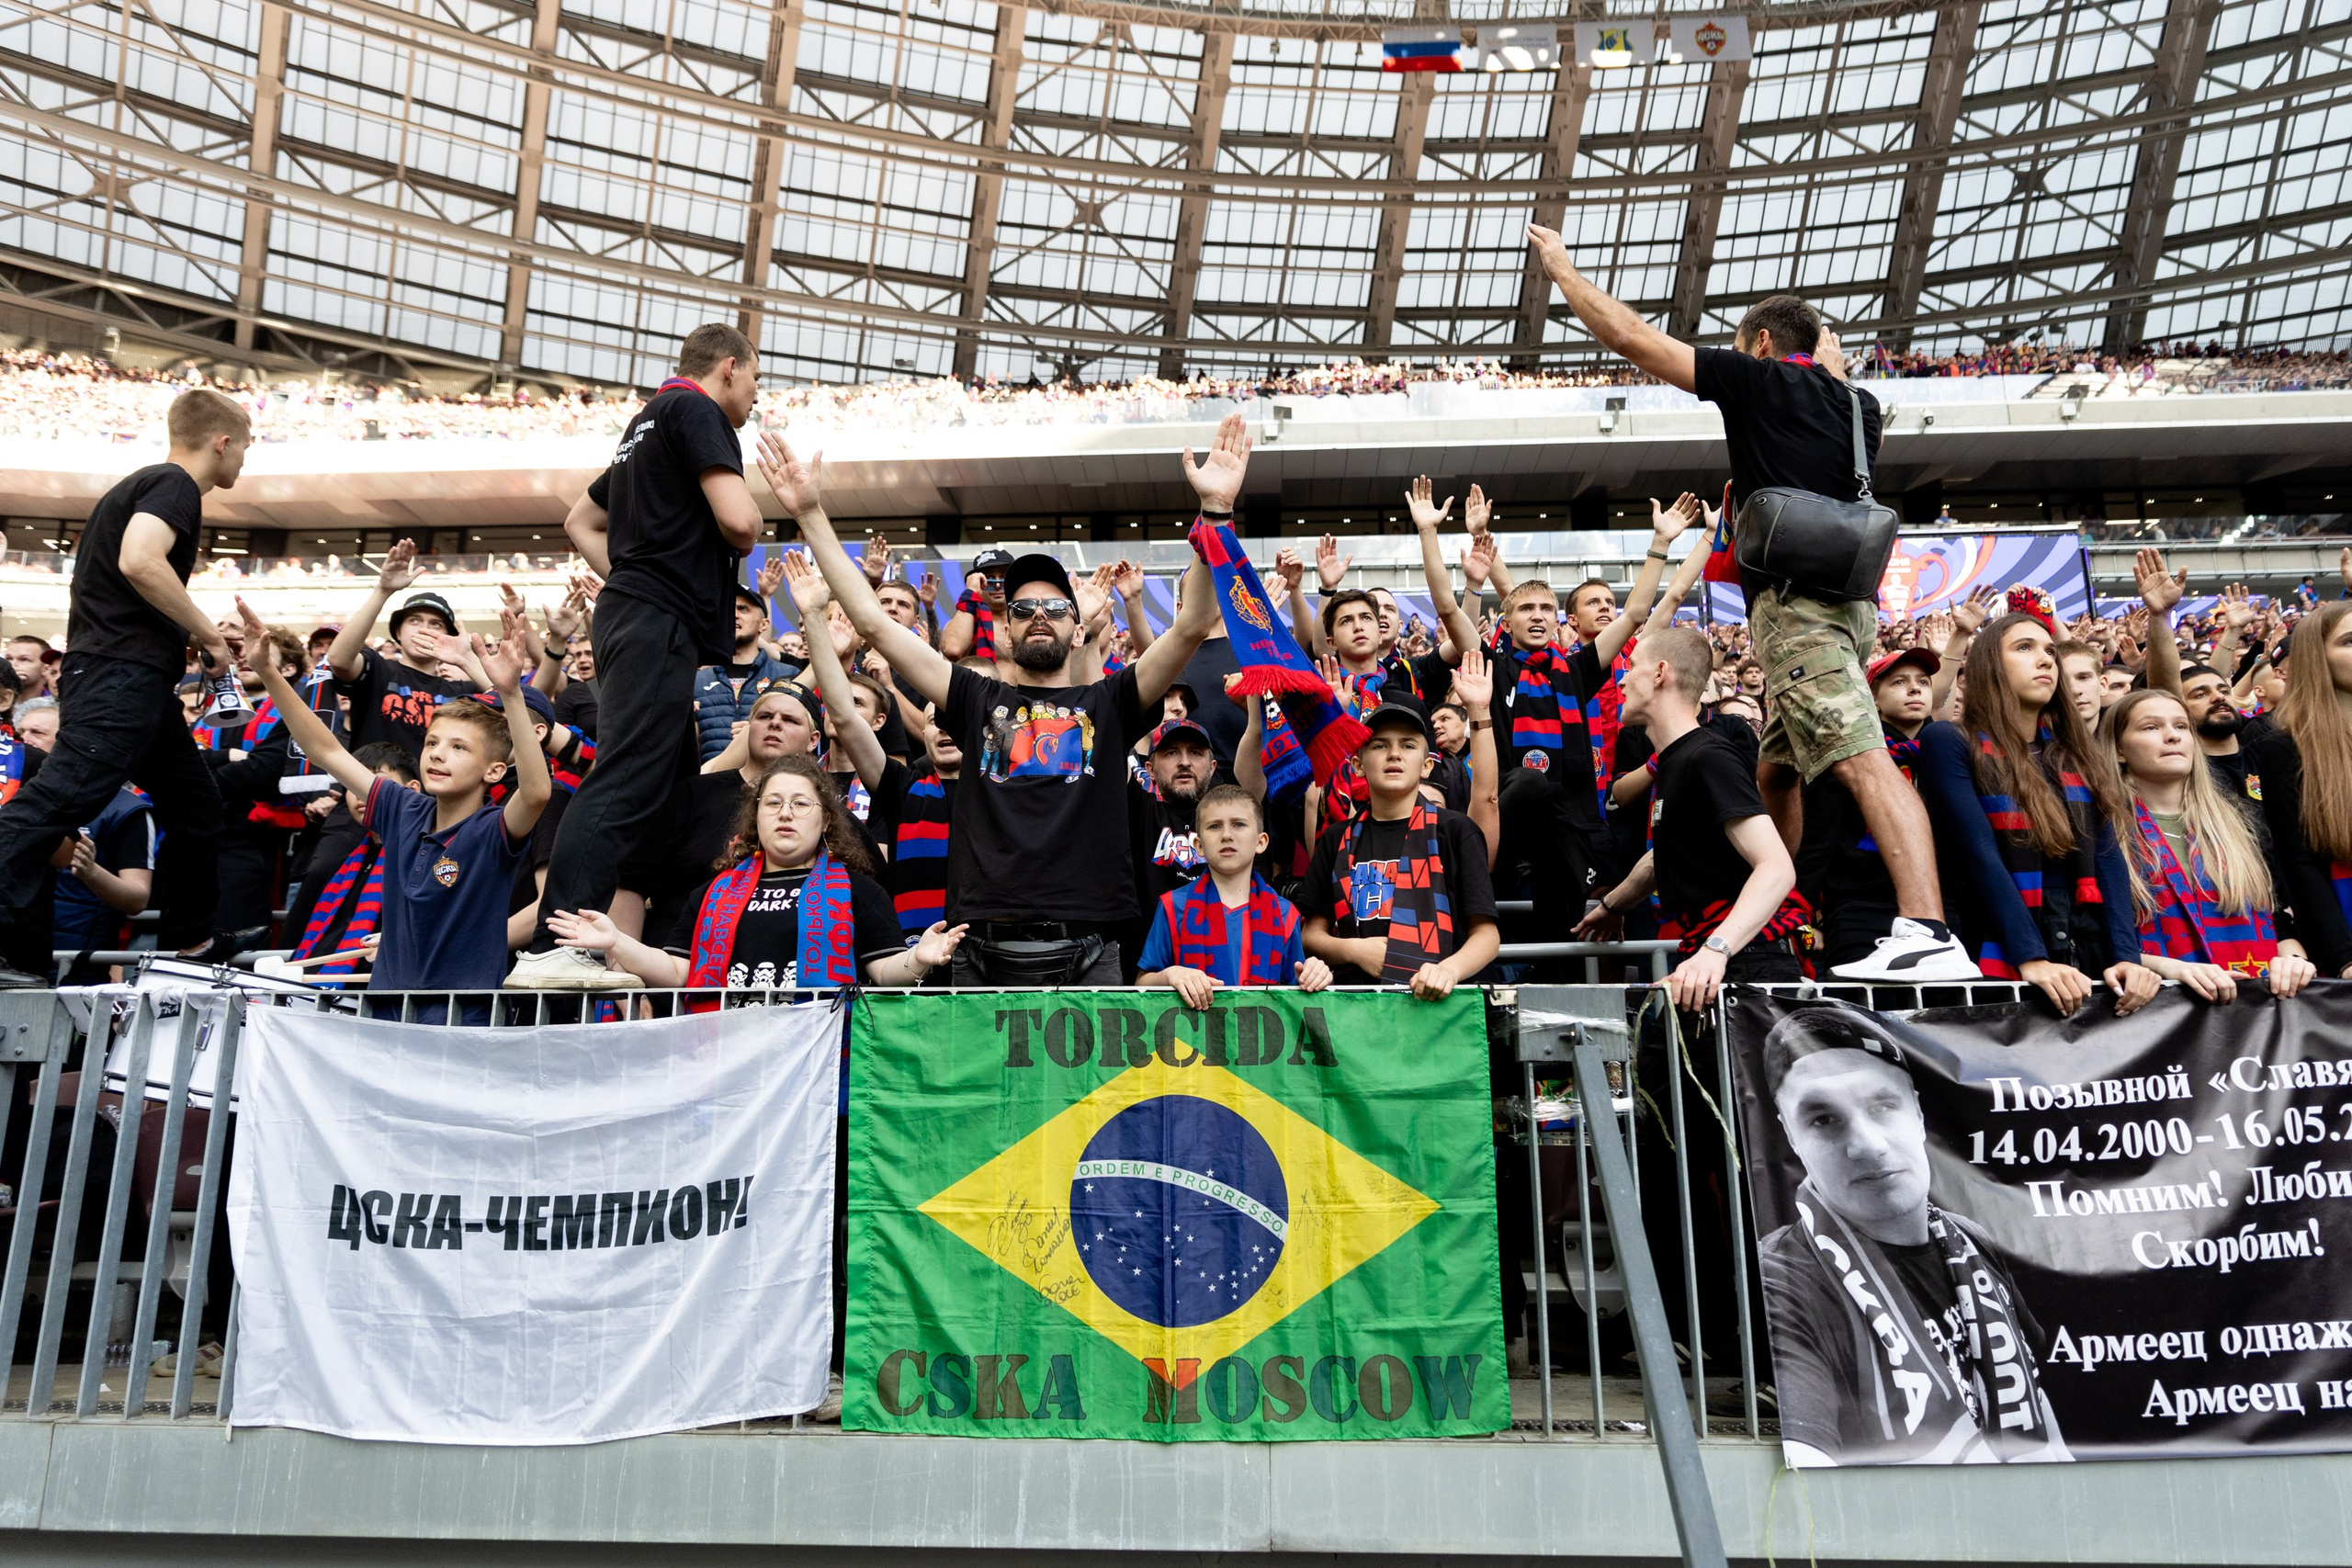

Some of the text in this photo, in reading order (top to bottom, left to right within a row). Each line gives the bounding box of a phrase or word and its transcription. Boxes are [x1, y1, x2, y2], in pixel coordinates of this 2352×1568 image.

[412, 690, 433, 704] PFC
[435, 864, 458, 876] ЦСКА
[748, 899, 793, 912] DARK
[804, 891, 824, 978] ТОЛЬКО
[995, 1006, 1340, 1068] TORCIDA
[1984, 1064, 2193, 1112] Позывной
[328, 1175, 755, 1251] ЦСКА-ЧЕМПИОН!
[1079, 1162, 1283, 1233] ORDEM E PROGRESSO
[2024, 1160, 2352, 1217] Помним! Люби
[2132, 1217, 2325, 1274] Скорбим!
[2046, 1320, 2352, 1372] Армеец однаж
[876, 1348, 1483, 1425] CSKA MOSCOW
[2142, 1379, 2306, 1426] Армеец
